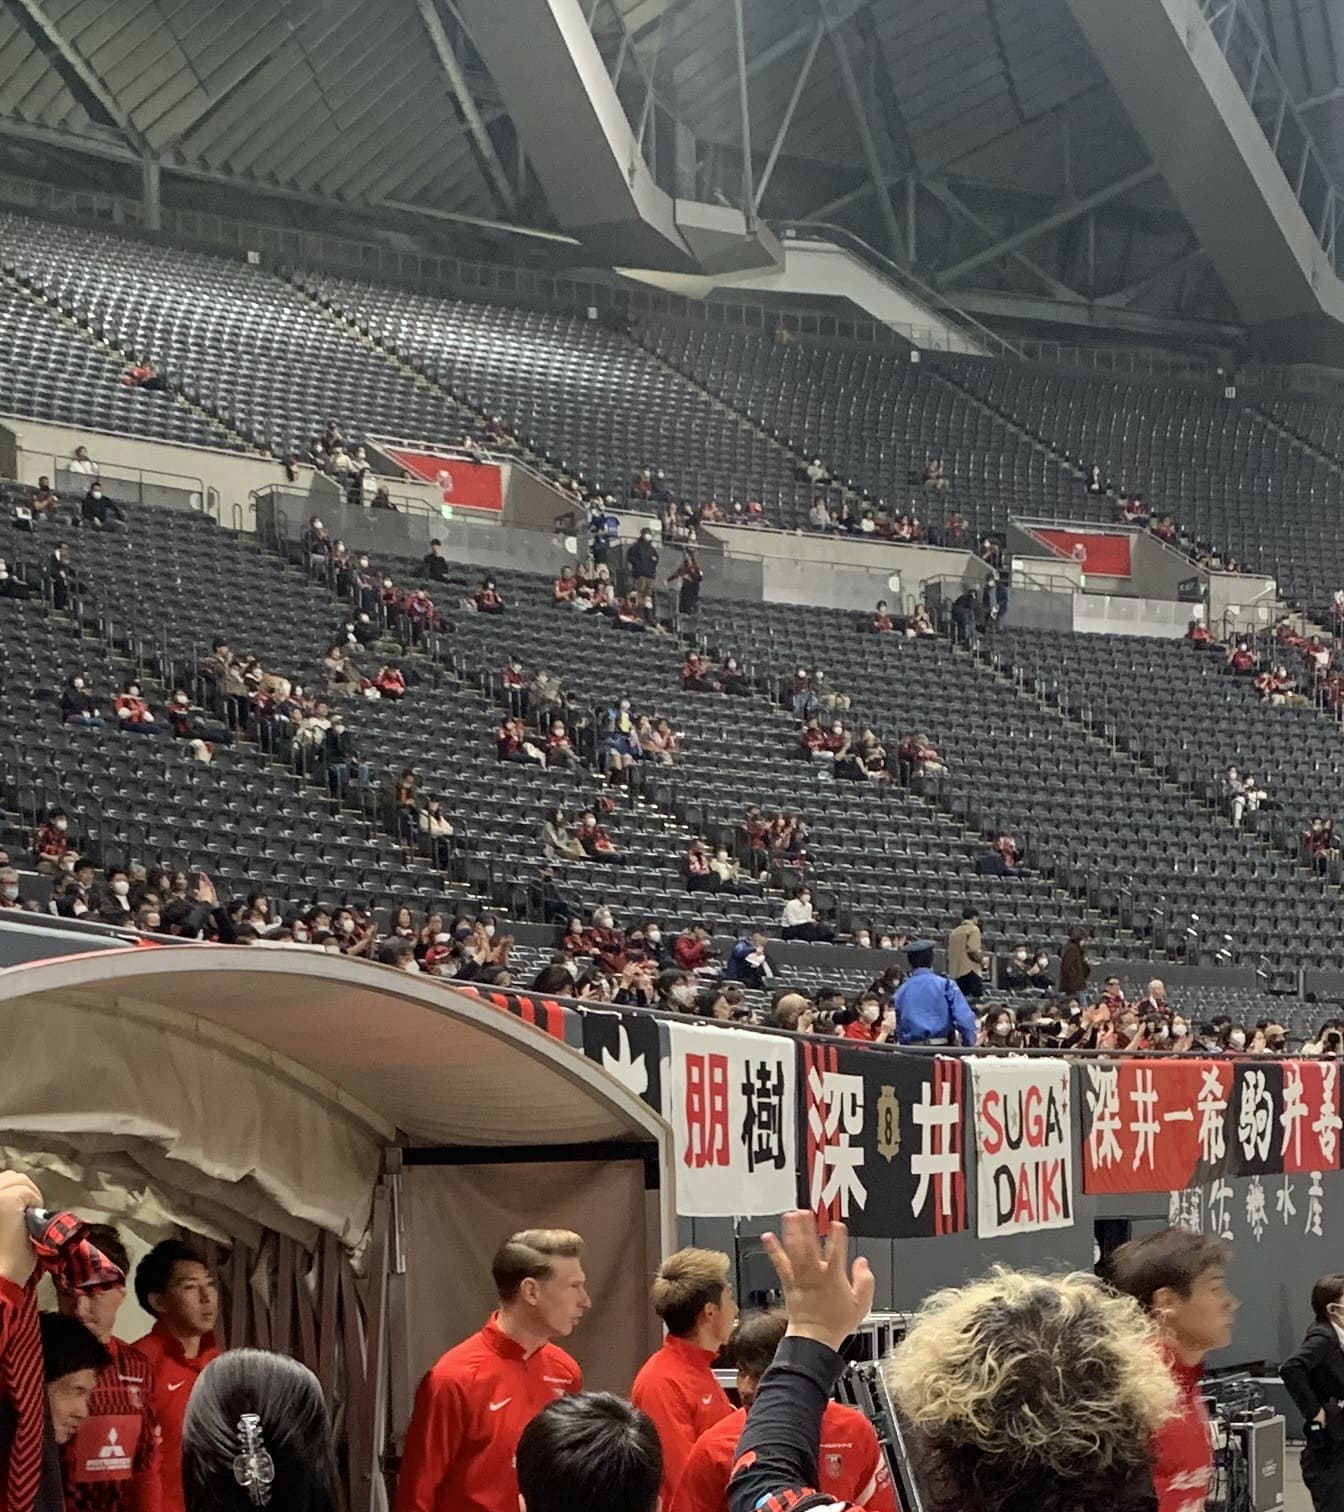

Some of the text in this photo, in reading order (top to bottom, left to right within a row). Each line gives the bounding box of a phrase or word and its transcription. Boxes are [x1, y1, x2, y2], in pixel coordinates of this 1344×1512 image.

[684, 1053, 786, 1173] 朋樹
[808, 1070, 959, 1218] 深井
[983, 1085, 1061, 1154] SUGA
[1086, 1064, 1228, 1172] 深井一希
[994, 1158, 1069, 1226] DAIKI
